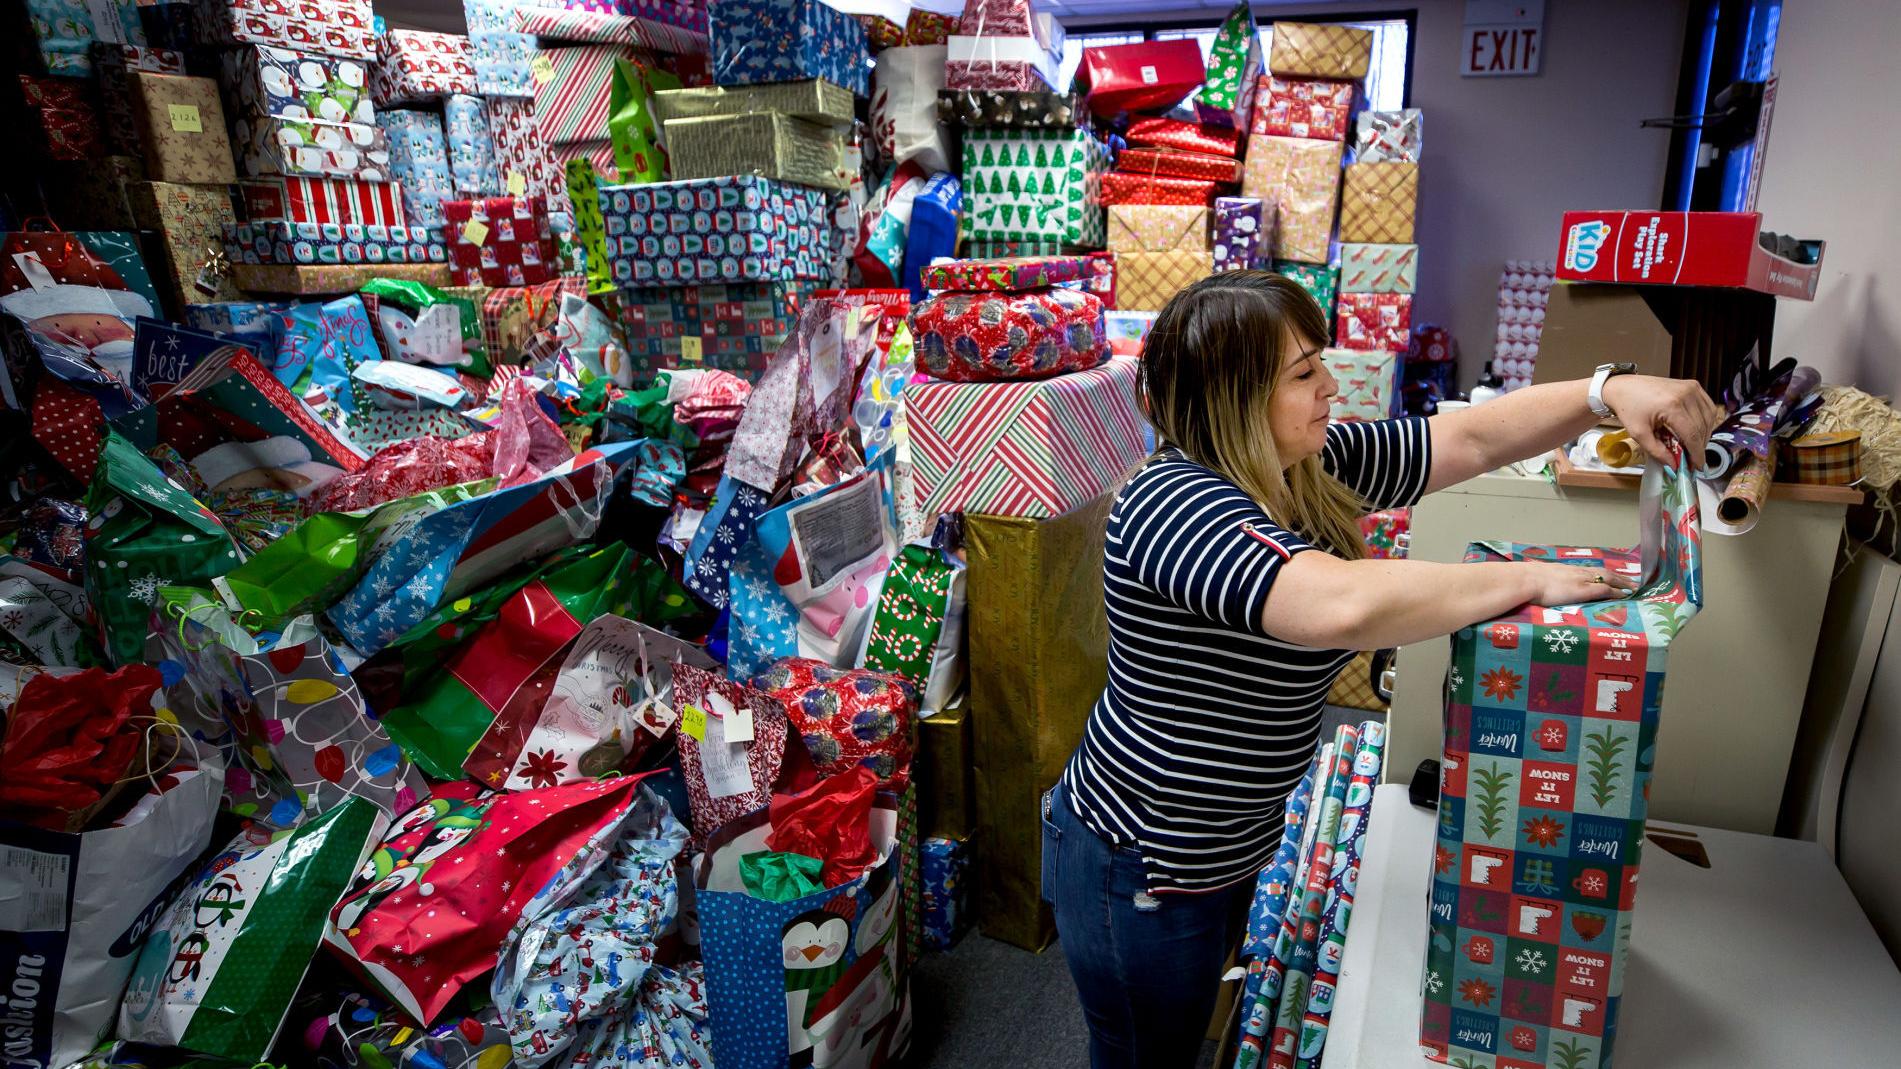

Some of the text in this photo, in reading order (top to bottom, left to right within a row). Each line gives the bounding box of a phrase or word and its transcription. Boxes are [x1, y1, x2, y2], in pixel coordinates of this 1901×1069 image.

[1471, 29, 1537, 71] EXIT
[1575, 223, 1601, 270] KID
[1632, 226, 1648, 269] Play Set
[1641, 216, 1661, 278] Exploration
[1655, 232, 1669, 263] Shark
[148, 339, 189, 383] best
[869, 621, 922, 662] HO
[1611, 639, 1627, 648] IT
[571, 627, 638, 680] Merry
[1604, 650, 1632, 661] LET
[1476, 715, 1521, 731] GREETINGS
[1478, 732, 1517, 752] Winter
[1529, 769, 1570, 782] SNOW
[1541, 782, 1556, 791] IT
[1534, 793, 1560, 804] LET
[1577, 822, 1623, 840] GREETINGS
[1578, 839, 1619, 860] Winter
[1565, 954, 1605, 968] SNOW
[1576, 967, 1591, 976] IT
[1570, 976, 1595, 987] LET
[1456, 1030, 1492, 1049] Winter
